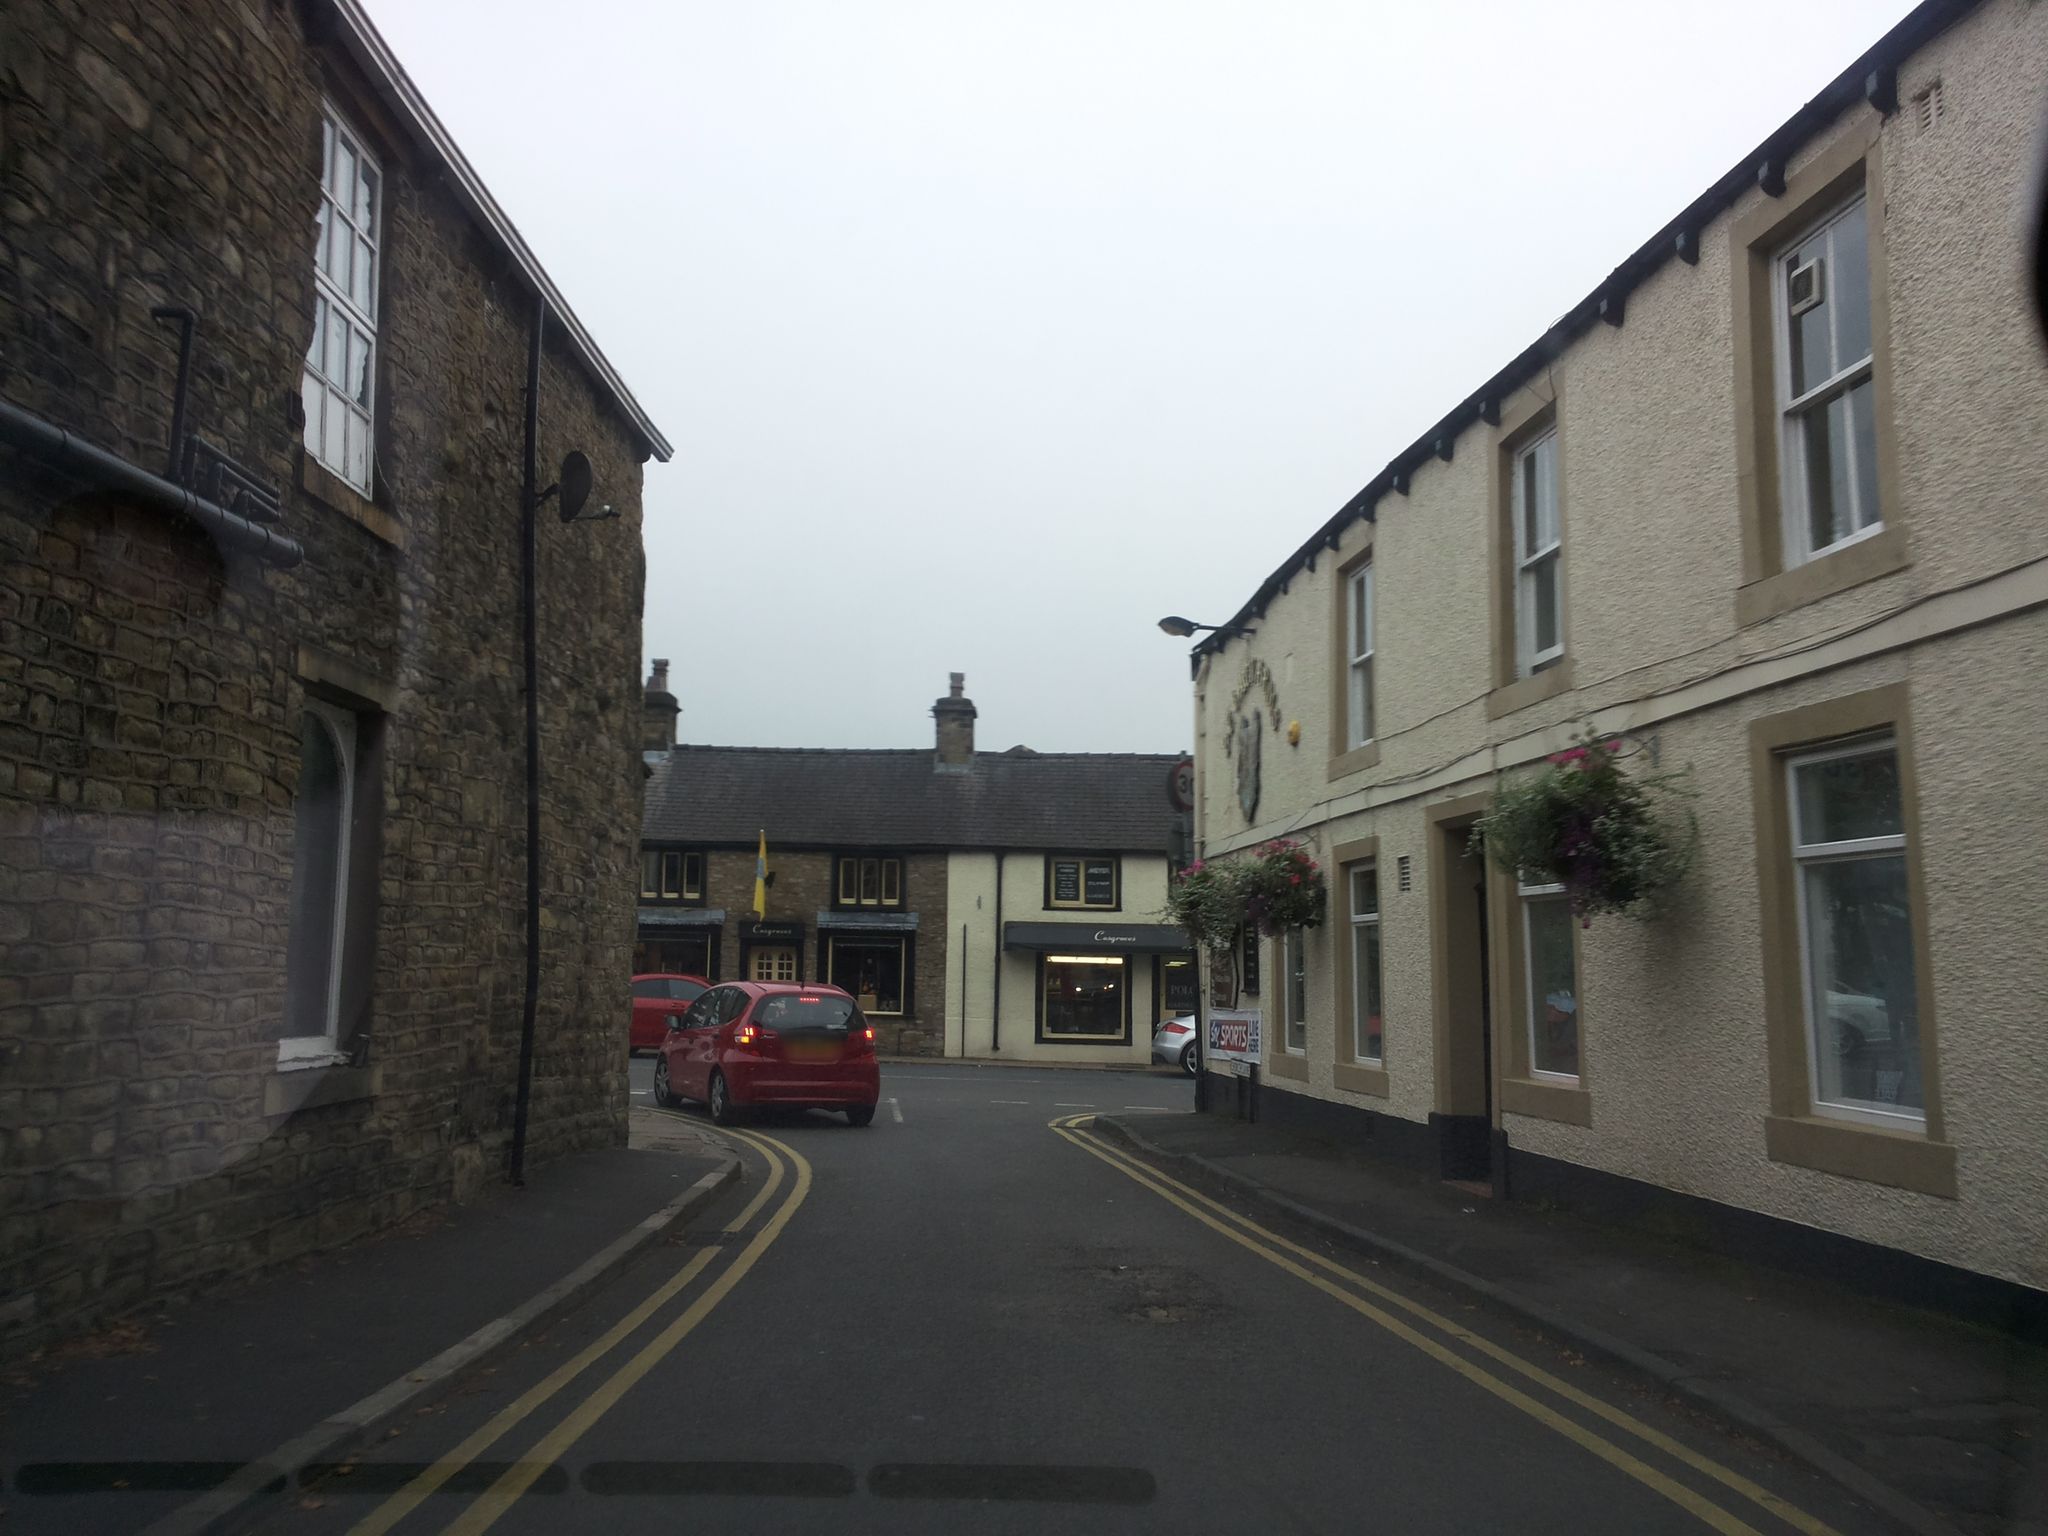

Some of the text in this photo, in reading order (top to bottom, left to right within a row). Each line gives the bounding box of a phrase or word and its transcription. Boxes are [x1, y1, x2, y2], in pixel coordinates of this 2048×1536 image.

[1211, 1022, 1247, 1048] sky SPORTS
[1249, 1020, 1259, 1037] LIVE
